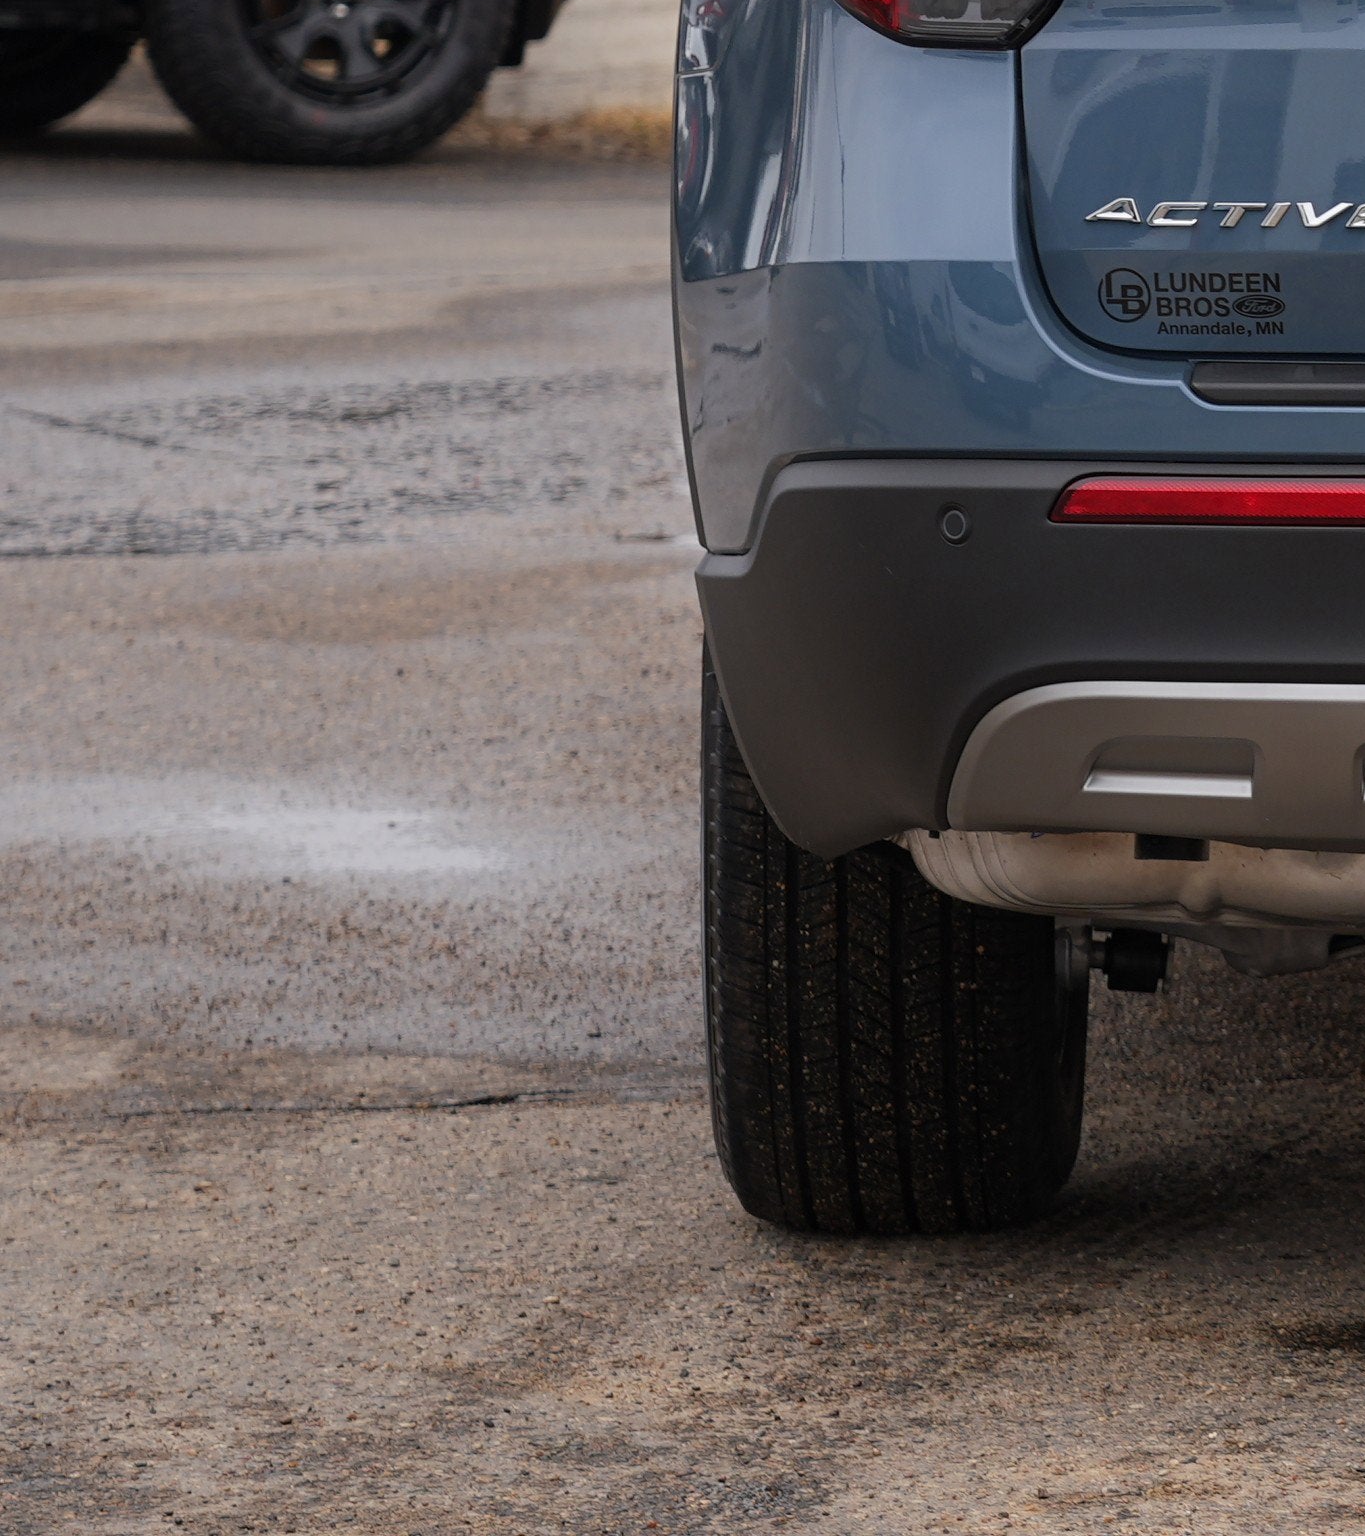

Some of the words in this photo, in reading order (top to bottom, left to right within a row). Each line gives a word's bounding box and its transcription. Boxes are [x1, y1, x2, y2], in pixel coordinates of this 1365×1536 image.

[1154, 272, 1281, 293] LUNDEEN
[1156, 297, 1231, 317] BROS
[1157, 322, 1251, 337] Annandale,
[1256, 322, 1284, 335] MN
